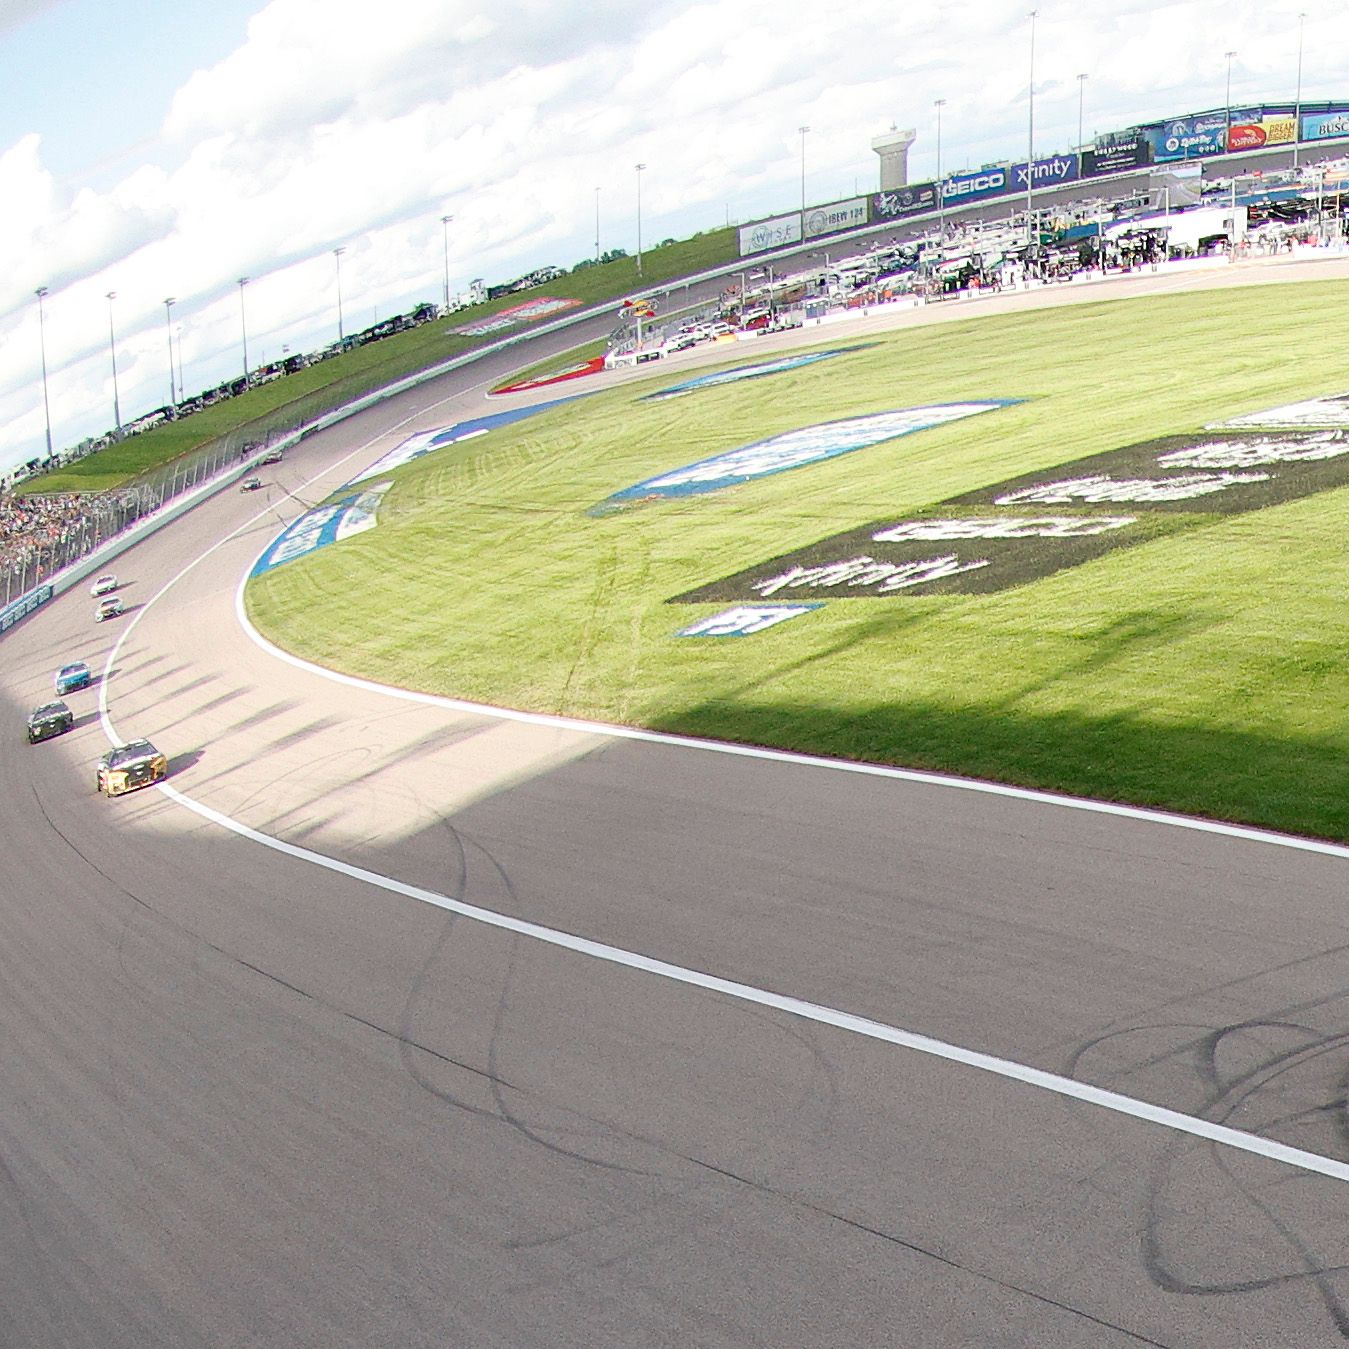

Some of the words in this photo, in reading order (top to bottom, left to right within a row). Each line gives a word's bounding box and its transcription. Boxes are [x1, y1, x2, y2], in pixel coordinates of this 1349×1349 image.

[1017, 158, 1072, 185] xfinity
[943, 173, 1005, 198] GEICO
[872, 515, 1138, 542] GEICO
[752, 553, 990, 597] xfinity
